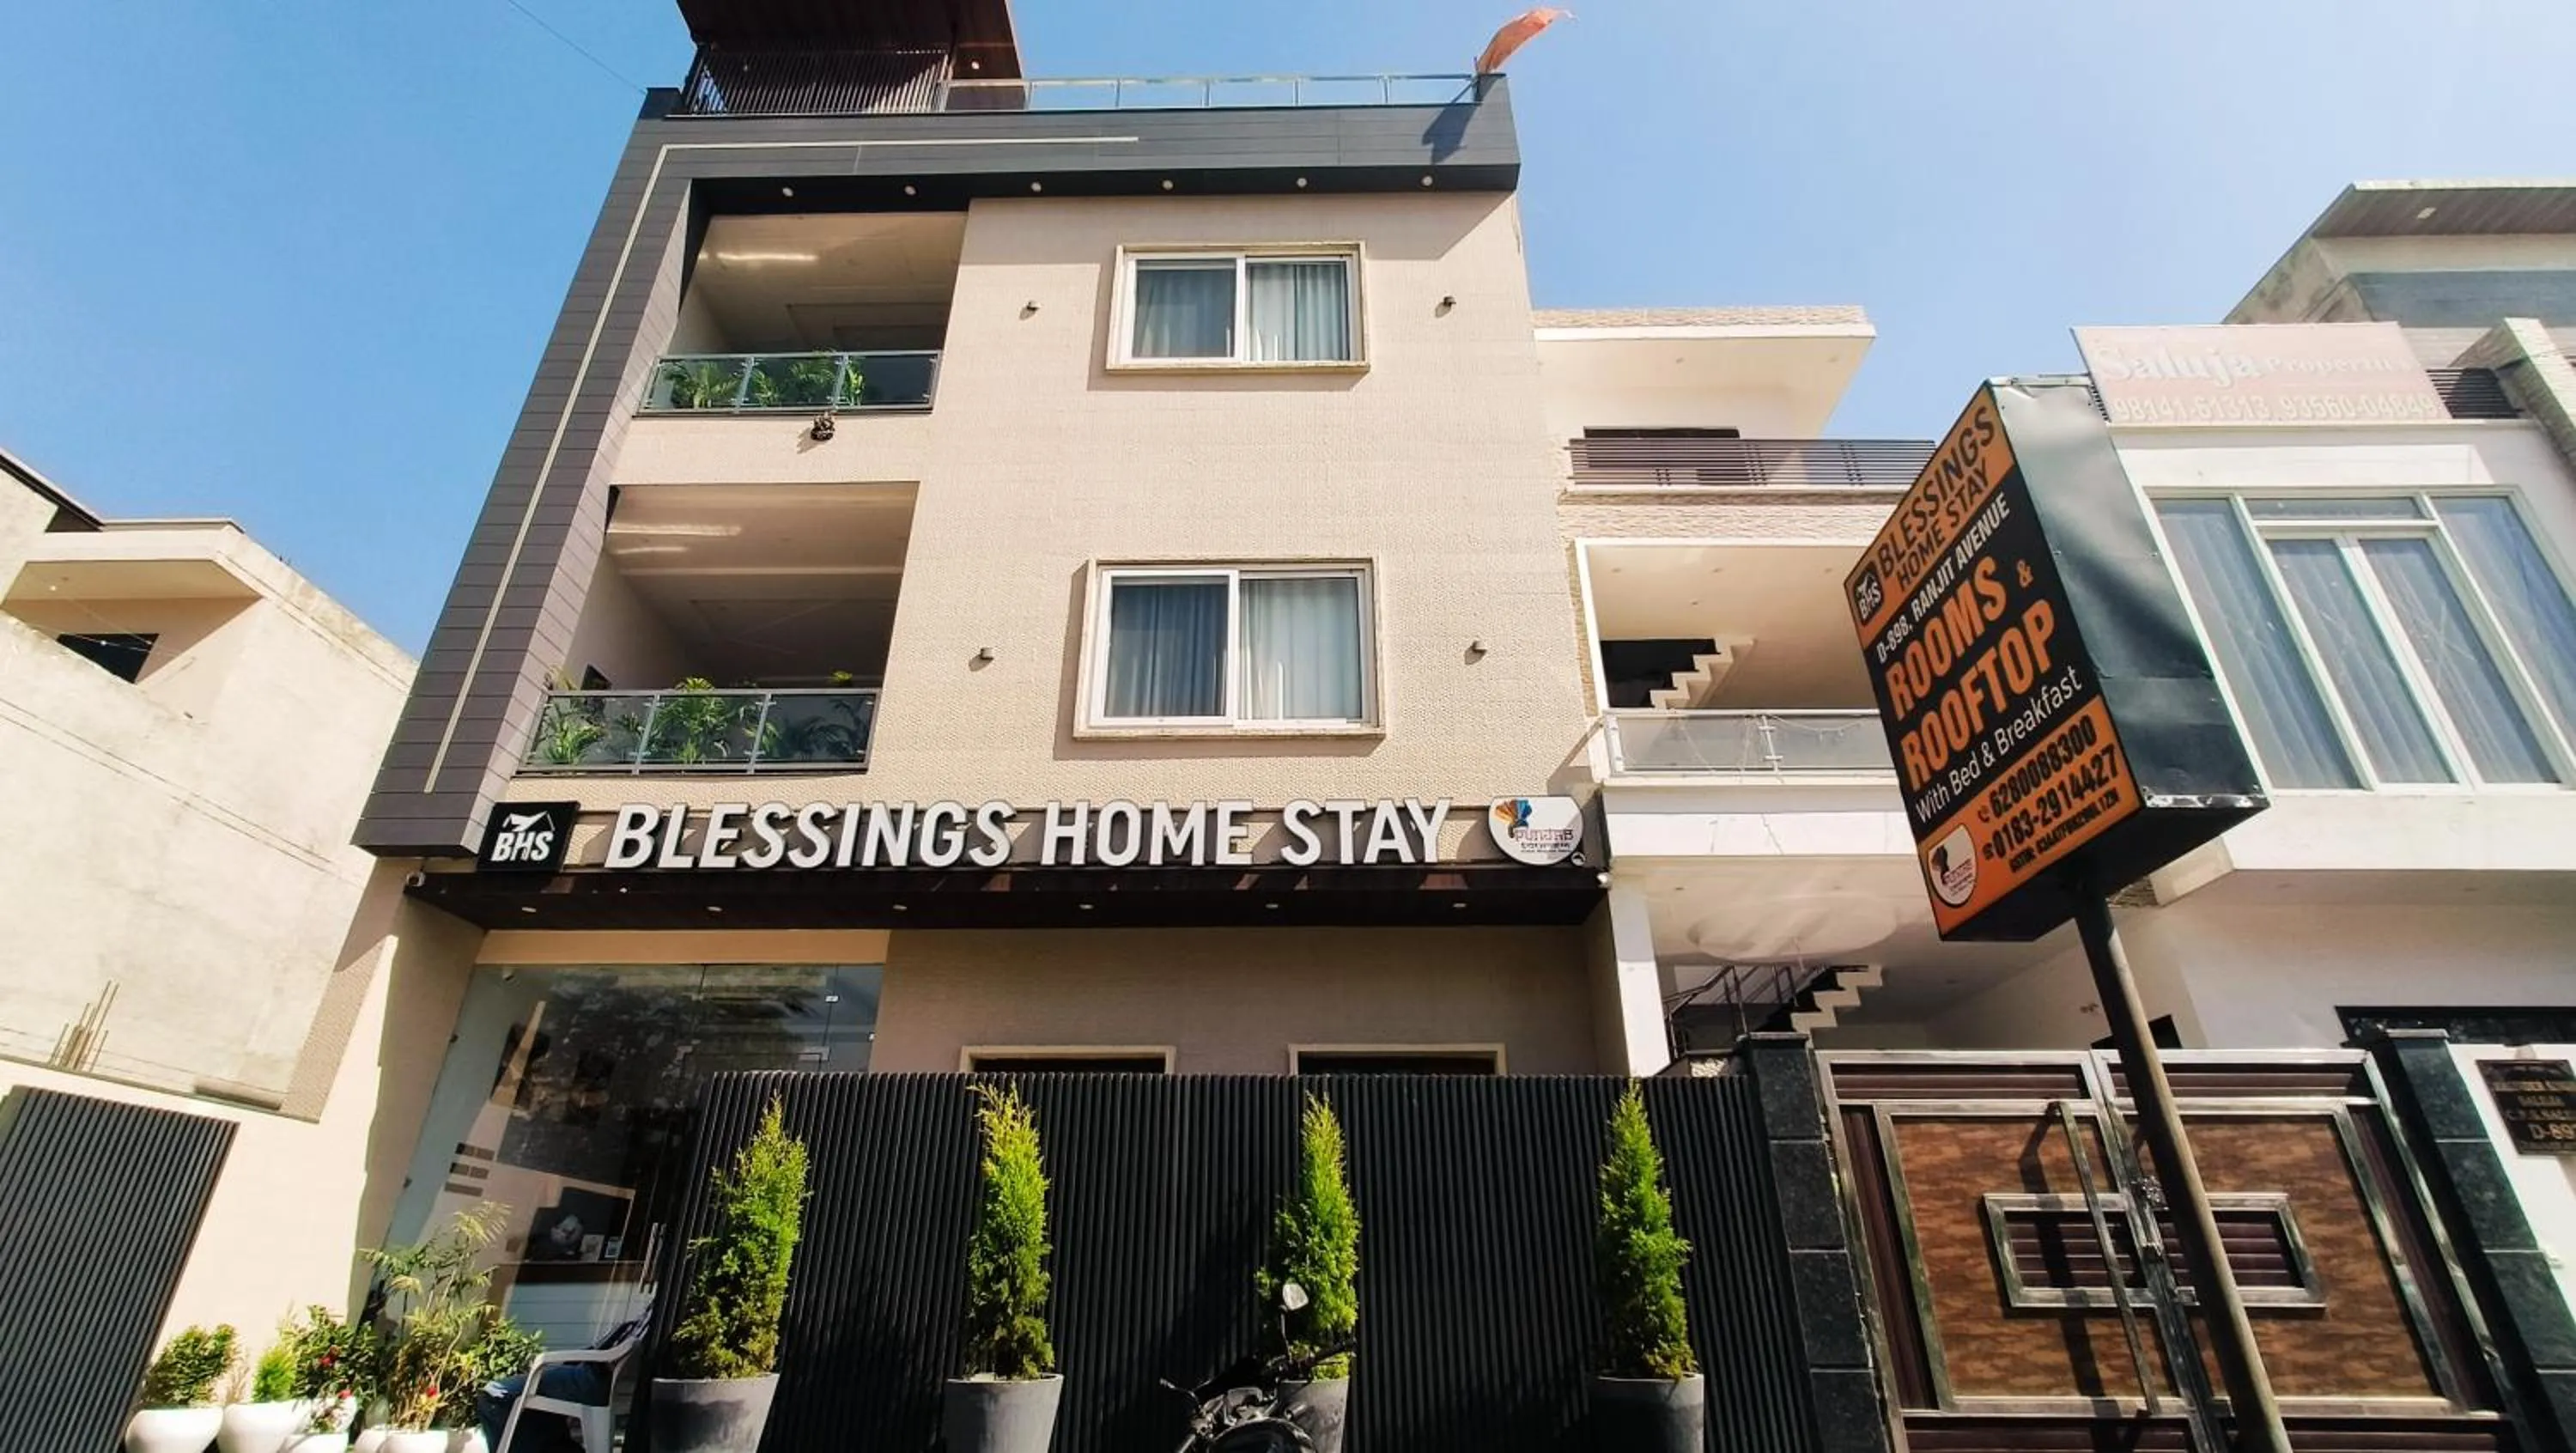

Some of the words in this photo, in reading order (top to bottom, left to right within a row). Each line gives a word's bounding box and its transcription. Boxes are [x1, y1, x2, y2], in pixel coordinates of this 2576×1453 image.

[2094, 345, 2263, 391] Saluja
[1878, 406, 1995, 578] BLESSINGS
[1896, 519, 1946, 592] HOME
[1946, 458, 1990, 528] STAY
[1857, 581, 1883, 619] BHS
[1911, 557, 1956, 622] RANJIT
[1955, 492, 2010, 570] AVENUE
[1885, 556, 2008, 721] ROOMS
[2016, 559, 2035, 588] &
[1900, 599, 2056, 793] ROOFTOP
[1915, 782, 1951, 824] With
[1950, 751, 1982, 797] Bed
[1981, 740, 1996, 768] &
[1995, 665, 2082, 756] Breakfast
[1989, 714, 2098, 818] 6280088300
[1991, 743, 2118, 859] 0183-2914427
[491, 830, 556, 864] BHS
[604, 799, 1019, 869] BLESSINGS
[1039, 799, 1256, 866] HOME
[1279, 796, 1455, 866] STAY
[2527, 1122, 2576, 1140] D-89
